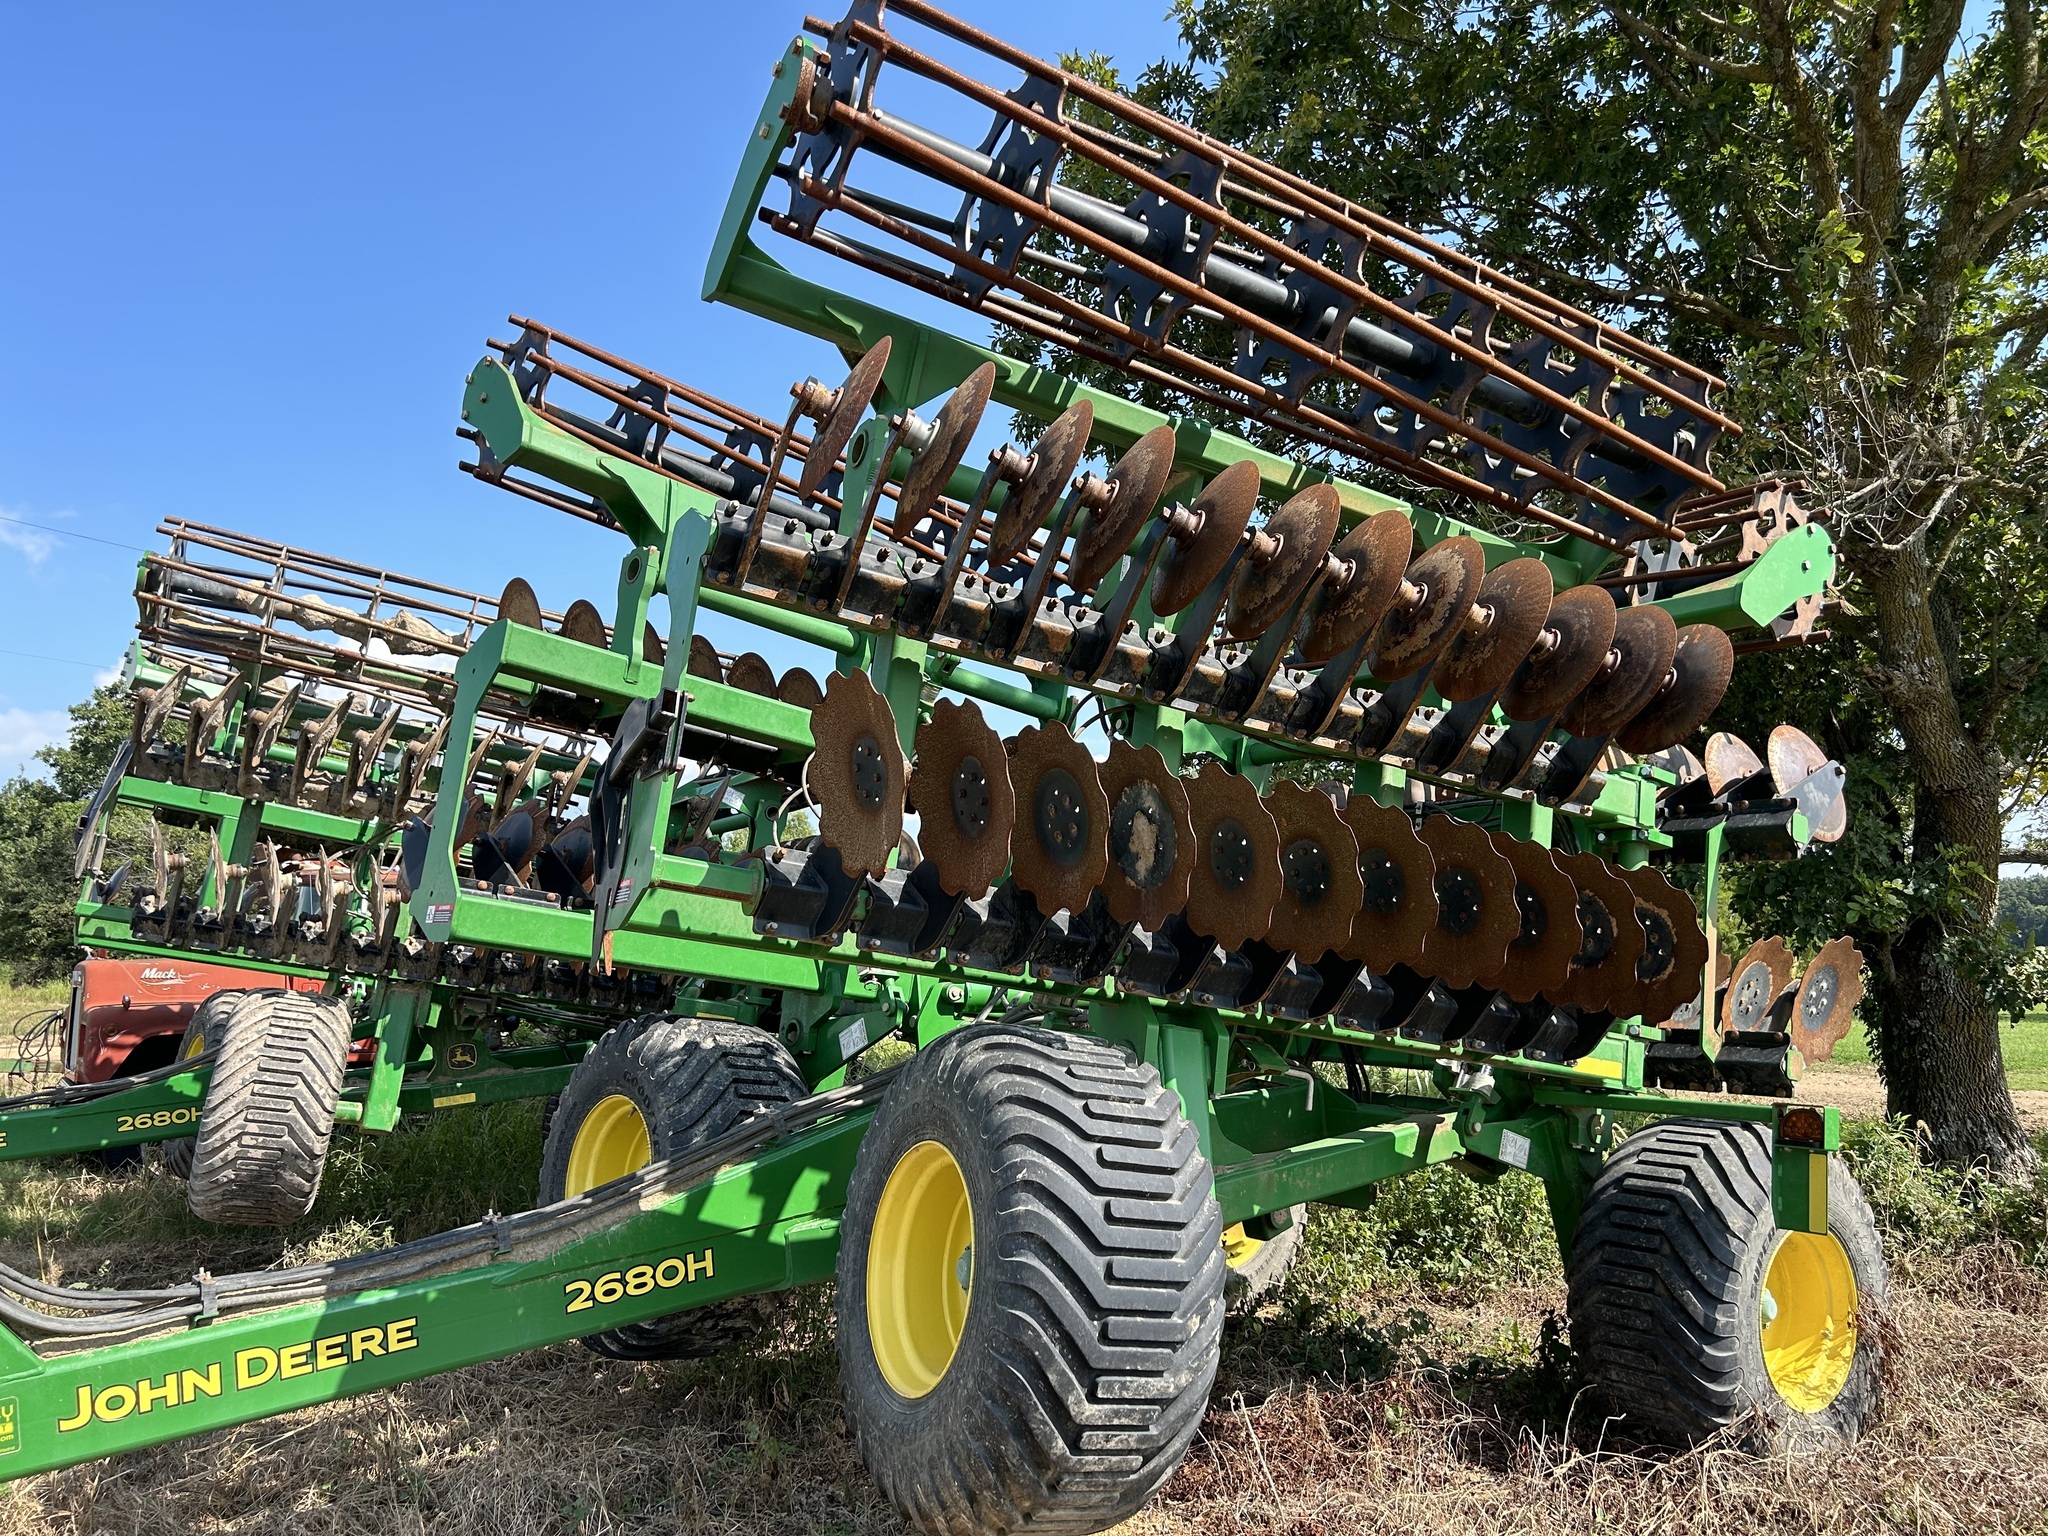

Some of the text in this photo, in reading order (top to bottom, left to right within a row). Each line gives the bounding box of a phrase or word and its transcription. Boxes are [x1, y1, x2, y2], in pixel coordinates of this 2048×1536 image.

[141, 967, 176, 980] Mack
[564, 1247, 715, 1314] 2680H
[58, 1316, 419, 1433] JOHN DEERE
